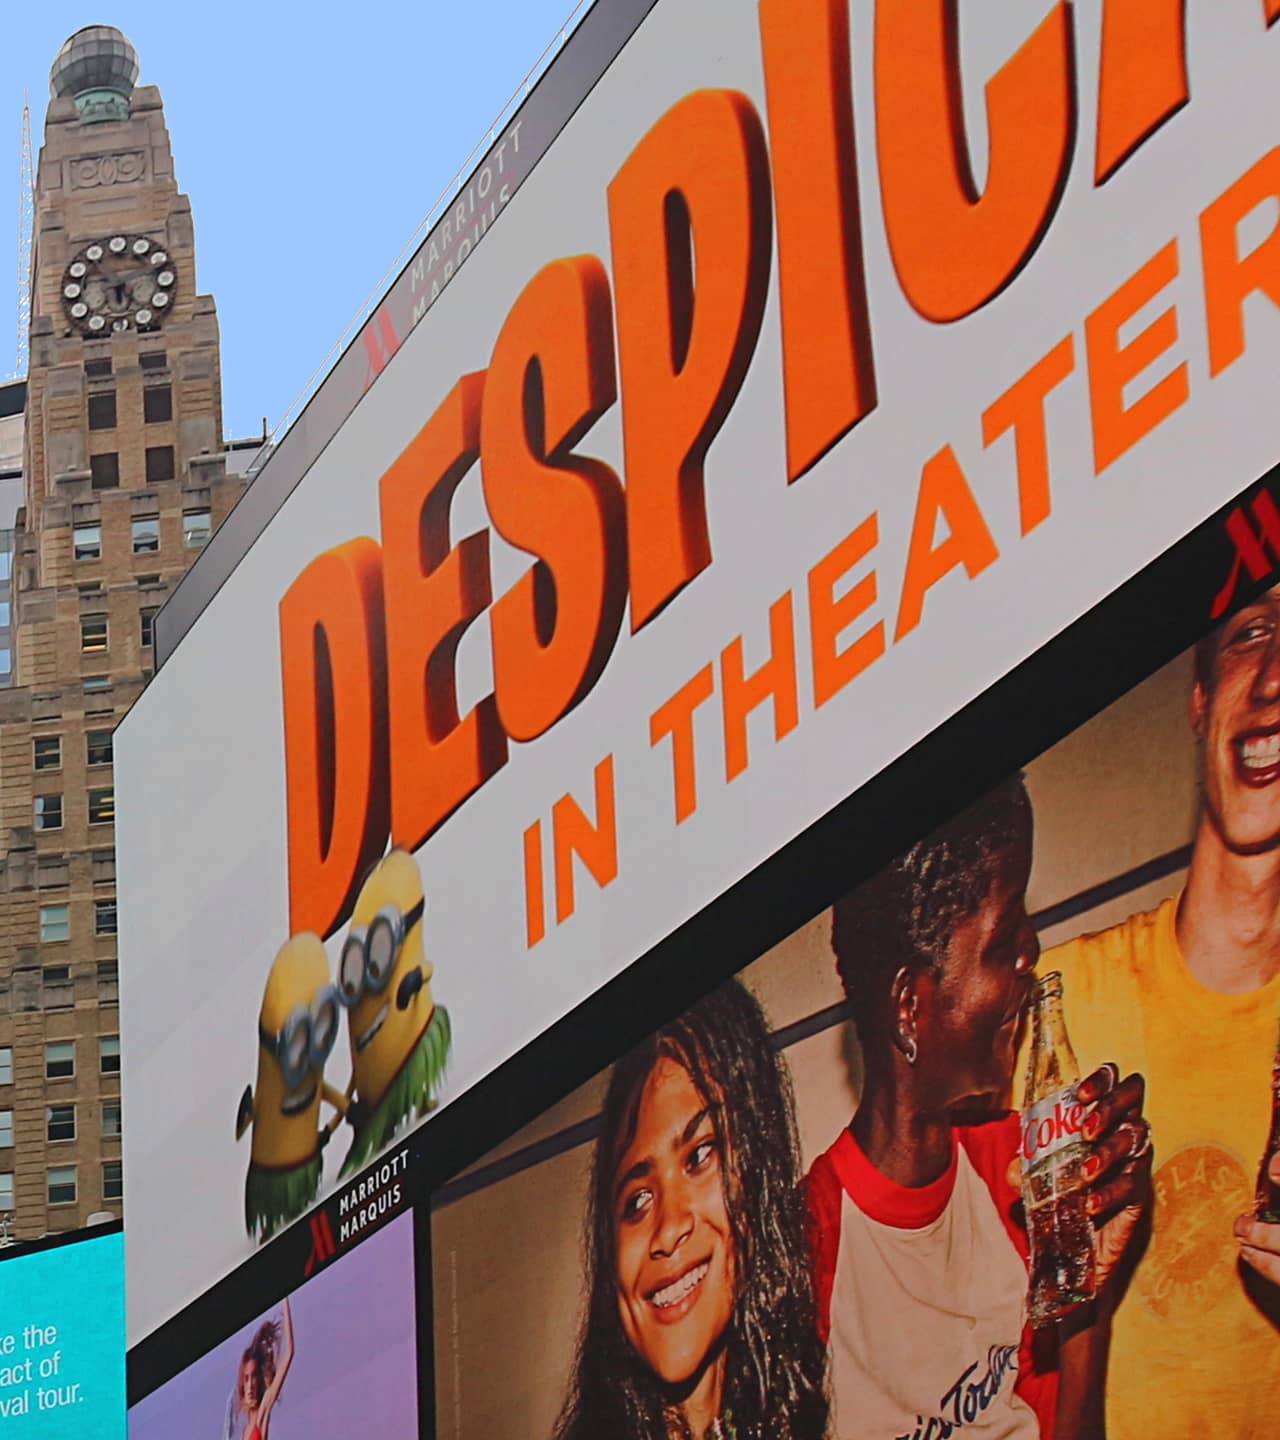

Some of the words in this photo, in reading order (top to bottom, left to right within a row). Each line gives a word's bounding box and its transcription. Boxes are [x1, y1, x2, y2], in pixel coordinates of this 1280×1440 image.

[410, 121, 523, 293] MARRIOTT
[278, 0, 1280, 942] DESPIC
[522, 752, 619, 950] IN
[1023, 1100, 1086, 1160] Coke
[339, 1148, 409, 1216] MARRIOTT
[339, 1183, 402, 1243] MARQUIS
[22, 1321, 58, 1352] the
[38, 1350, 61, 1381] of
[36, 1383, 85, 1413] tour.
